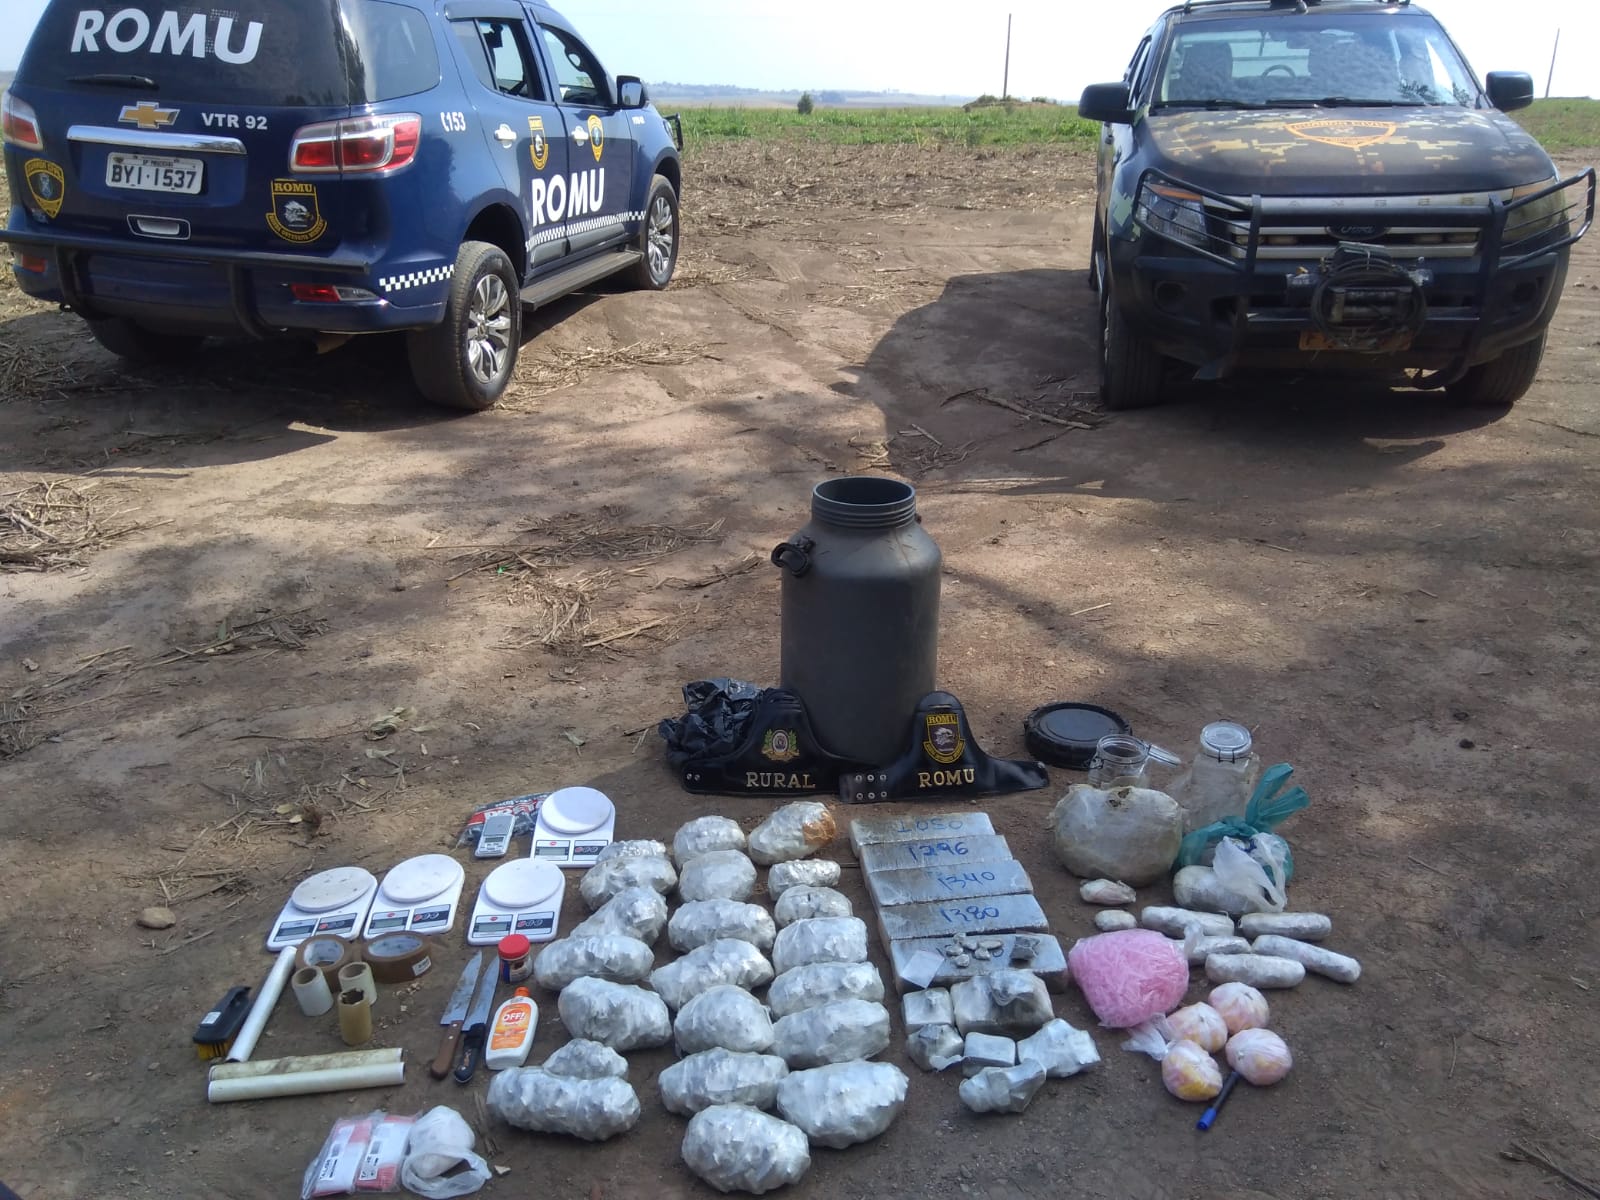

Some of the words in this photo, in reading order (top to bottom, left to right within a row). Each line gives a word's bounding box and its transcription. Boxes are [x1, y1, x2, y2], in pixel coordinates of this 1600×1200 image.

[71, 8, 264, 64] ROMU
[201, 112, 240, 128] VTR
[245, 115, 268, 130] 92
[446, 112, 466, 131] 153
[274, 182, 313, 193] ROMU
[531, 168, 605, 227] ROMU
[928, 714, 956, 724] ROMU
[746, 771, 816, 789] RURAL
[918, 768, 975, 788] ROMU
[908, 842, 969, 861] 1296
[937, 871, 996, 891] 1340
[503, 1011, 526, 1021] OFF!
